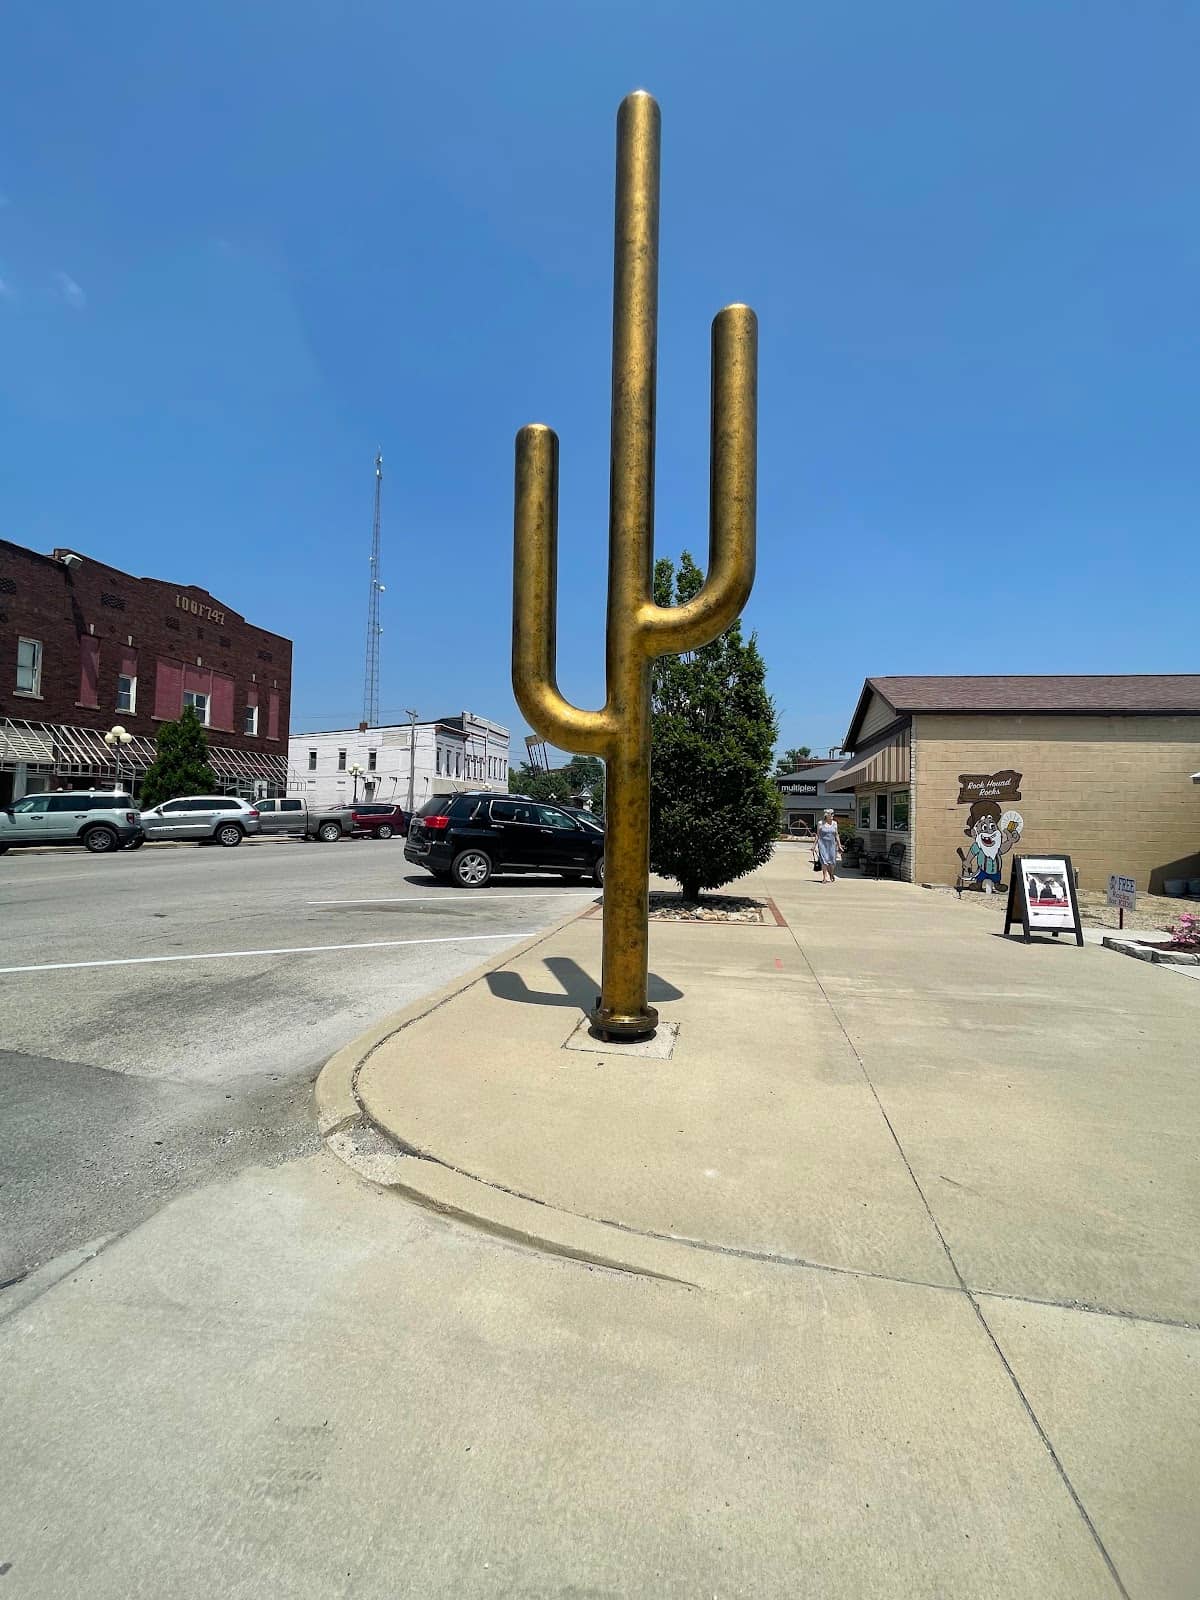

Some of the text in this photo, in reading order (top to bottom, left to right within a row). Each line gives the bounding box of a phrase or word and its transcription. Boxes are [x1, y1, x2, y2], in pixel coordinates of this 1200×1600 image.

[781, 783, 816, 793] multiplex
[967, 778, 1011, 790] Rock Hound
[979, 788, 1001, 797] Rocks
[1119, 877, 1135, 893] FREE
